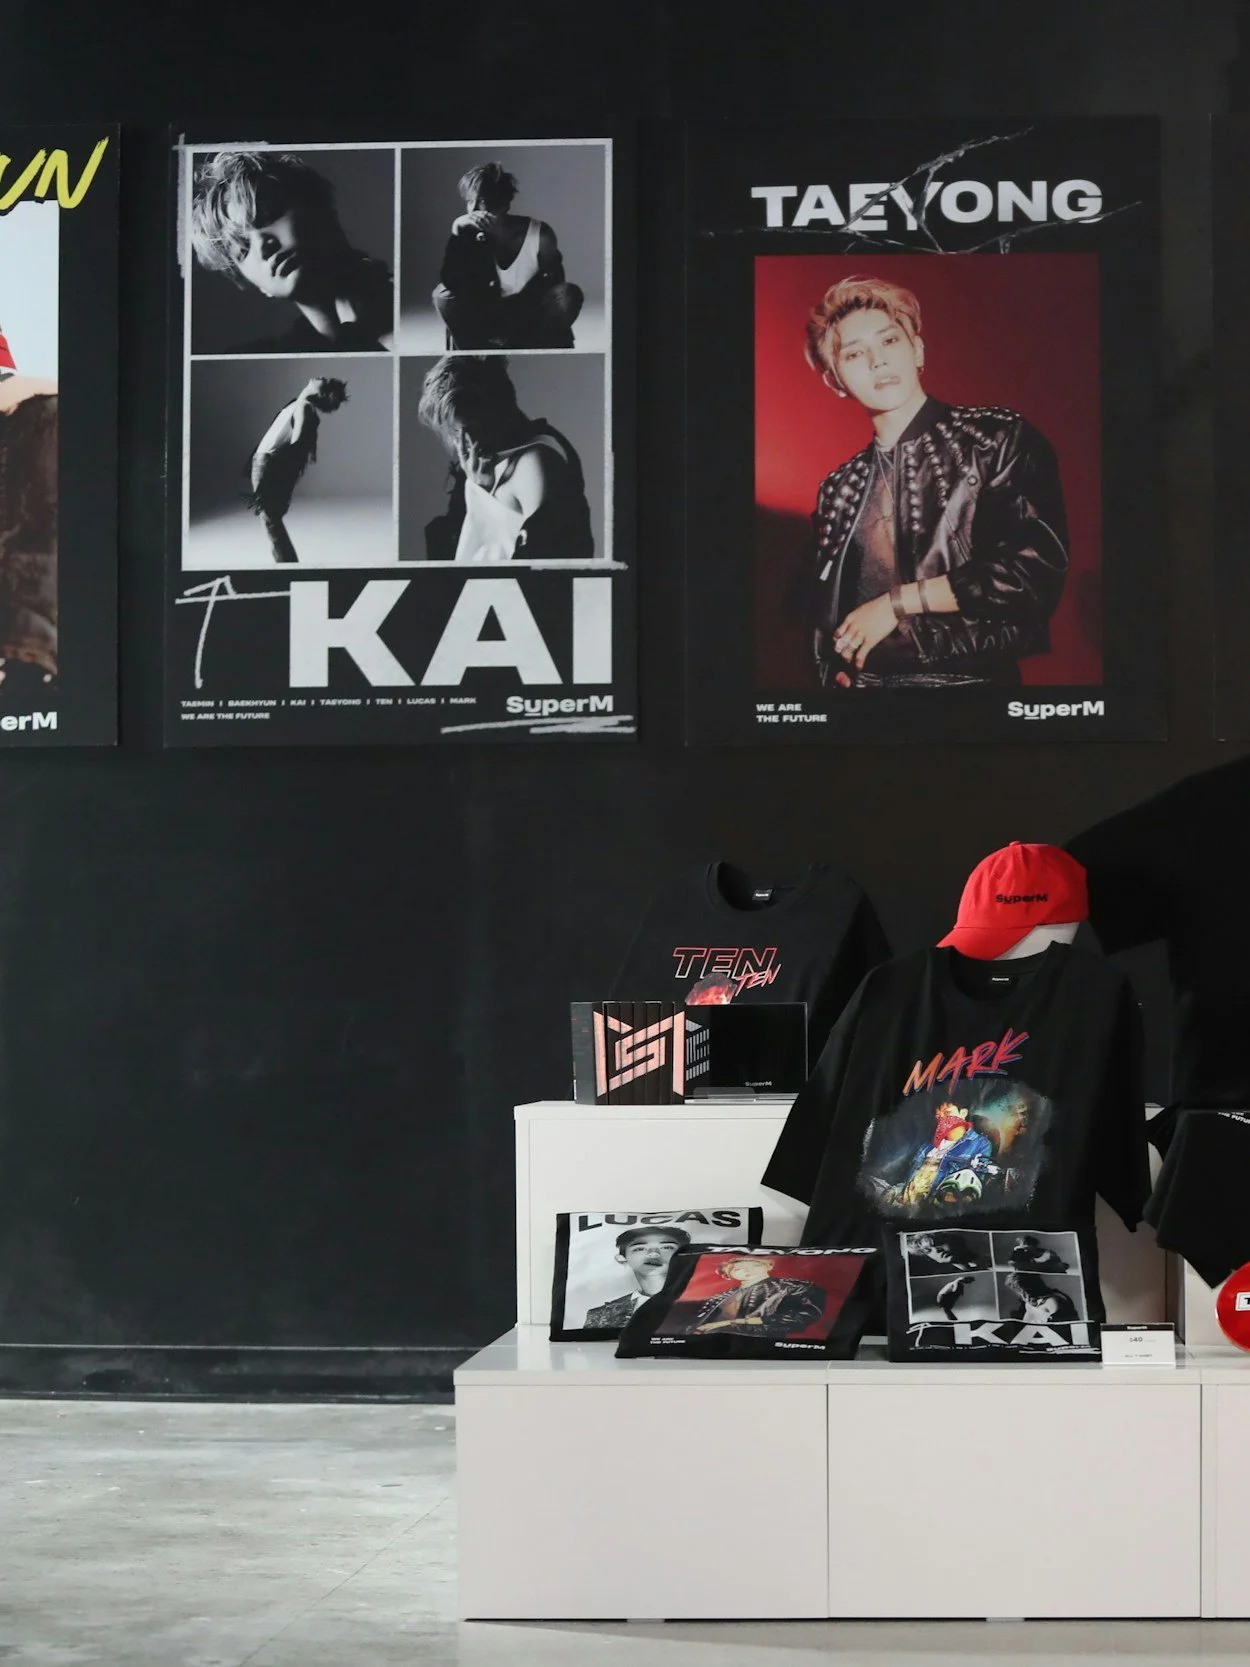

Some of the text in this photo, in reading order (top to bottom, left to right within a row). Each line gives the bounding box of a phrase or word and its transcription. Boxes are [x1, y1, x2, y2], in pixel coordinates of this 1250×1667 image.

[751, 179, 1103, 231] TAEYONG
[288, 577, 612, 687] KAI
[235, 712, 270, 720] FUTURE
[506, 695, 614, 716] SuperM
[756, 703, 802, 712] WE ARE
[1008, 701, 1105, 720] SuperM
[756, 714, 827, 723] THE FUTURE
[996, 893, 1048, 904] SuperM
[673, 947, 777, 979] TEN
[735, 963, 782, 997] TEN
[902, 1027, 1030, 1097] MARK
[578, 1210, 742, 1232] LUCAS
[954, 1322, 1090, 1347] KAI
[774, 1341, 826, 1350] SuperM
